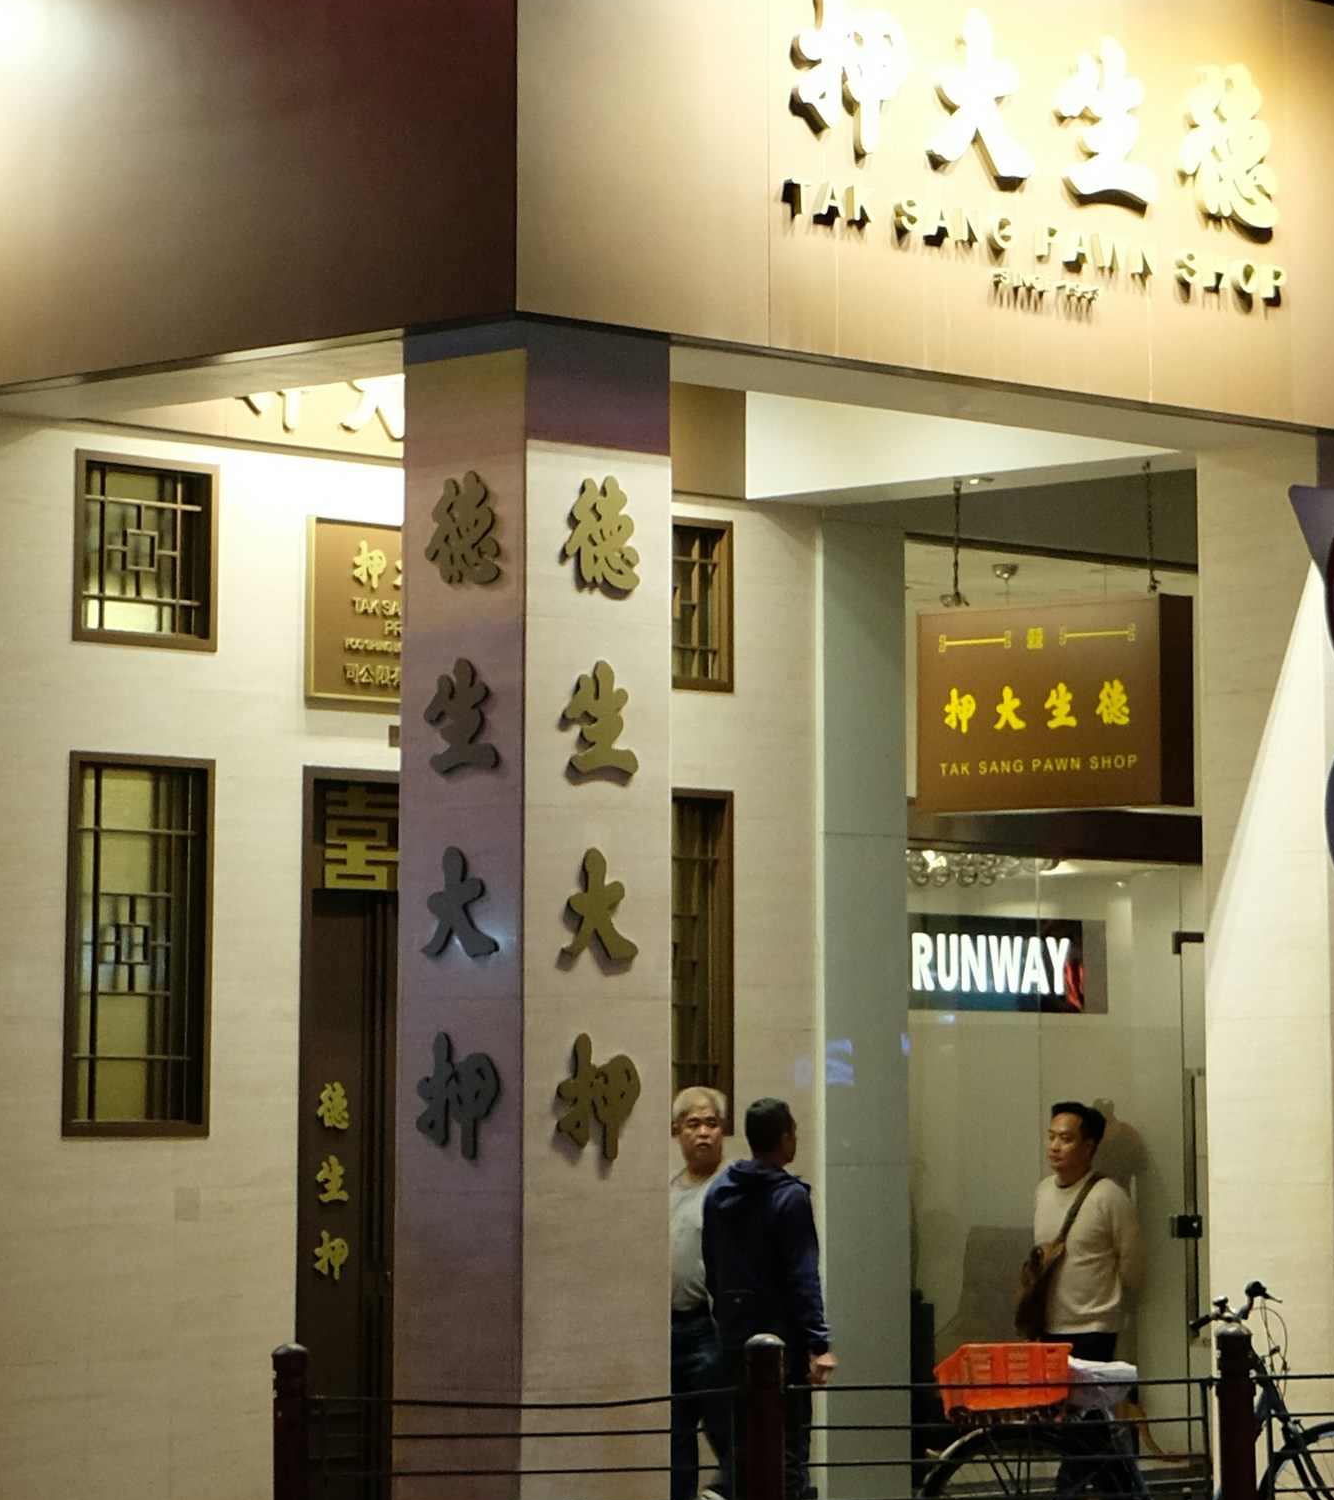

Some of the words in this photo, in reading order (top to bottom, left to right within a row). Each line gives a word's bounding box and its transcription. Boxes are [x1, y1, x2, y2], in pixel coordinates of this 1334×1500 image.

[783, 178, 875, 224] TAK
[894, 197, 1018, 250] SANG
[1035, 225, 1154, 276] PAWN
[1177, 251, 1287, 304] SHOP
[353, 597, 380, 616] TAK
[417, 470, 502, 1160] 德生大押
[557, 475, 641, 1160] 德生大押
[940, 763, 969, 776] TAK
[978, 759, 1023, 775] SANG
[1032, 757, 1080, 772] PAWN
[1089, 754, 1138, 770] SHOP
[911, 932, 1070, 995] RUNWAY
[314, 1081, 349, 1280] 德生押
